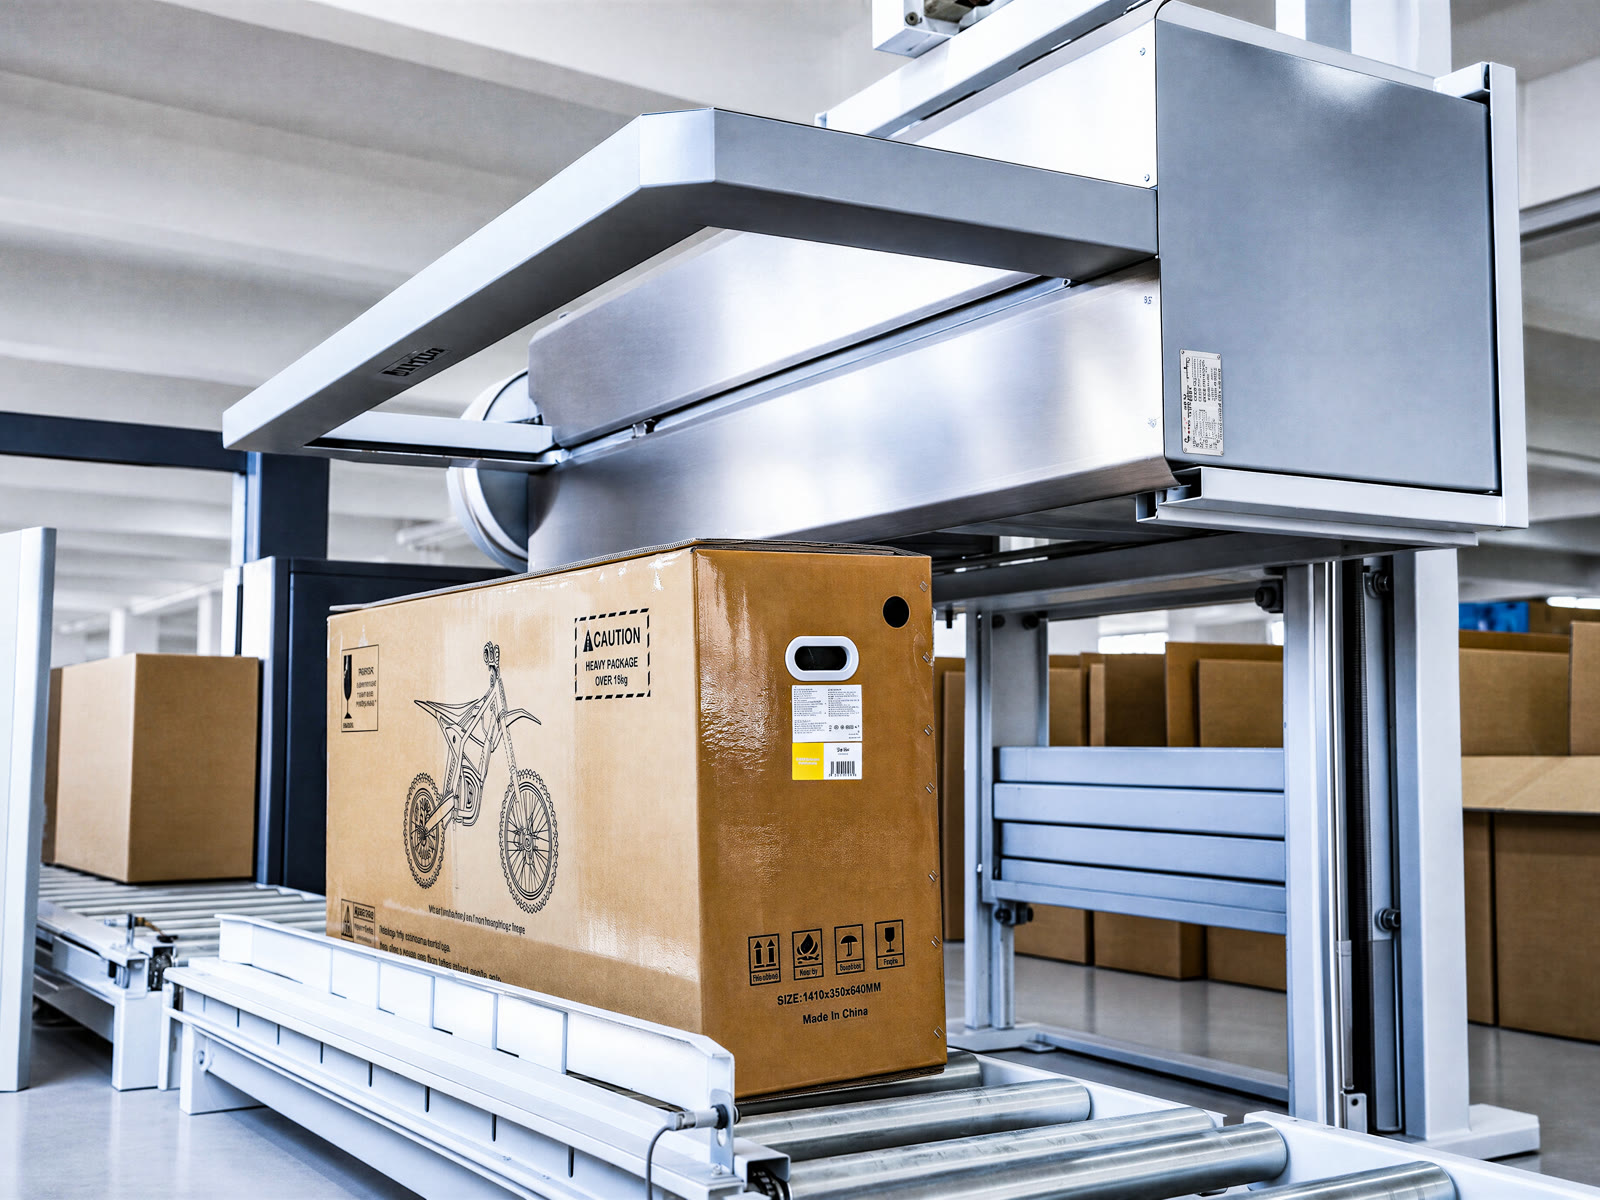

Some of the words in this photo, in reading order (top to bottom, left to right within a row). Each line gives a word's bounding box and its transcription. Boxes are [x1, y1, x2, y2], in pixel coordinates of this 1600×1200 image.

[593, 627, 640, 648] CAUTION
[585, 659, 606, 671] HEAVY
[606, 656, 638, 669] PACKAGE
[595, 675, 613, 686] OVER
[777, 982, 881, 1006] SIZE:1410x350x640MM
[802, 1012, 829, 1025] Made
[831, 1010, 840, 1021] In
[842, 1007, 868, 1019] China
